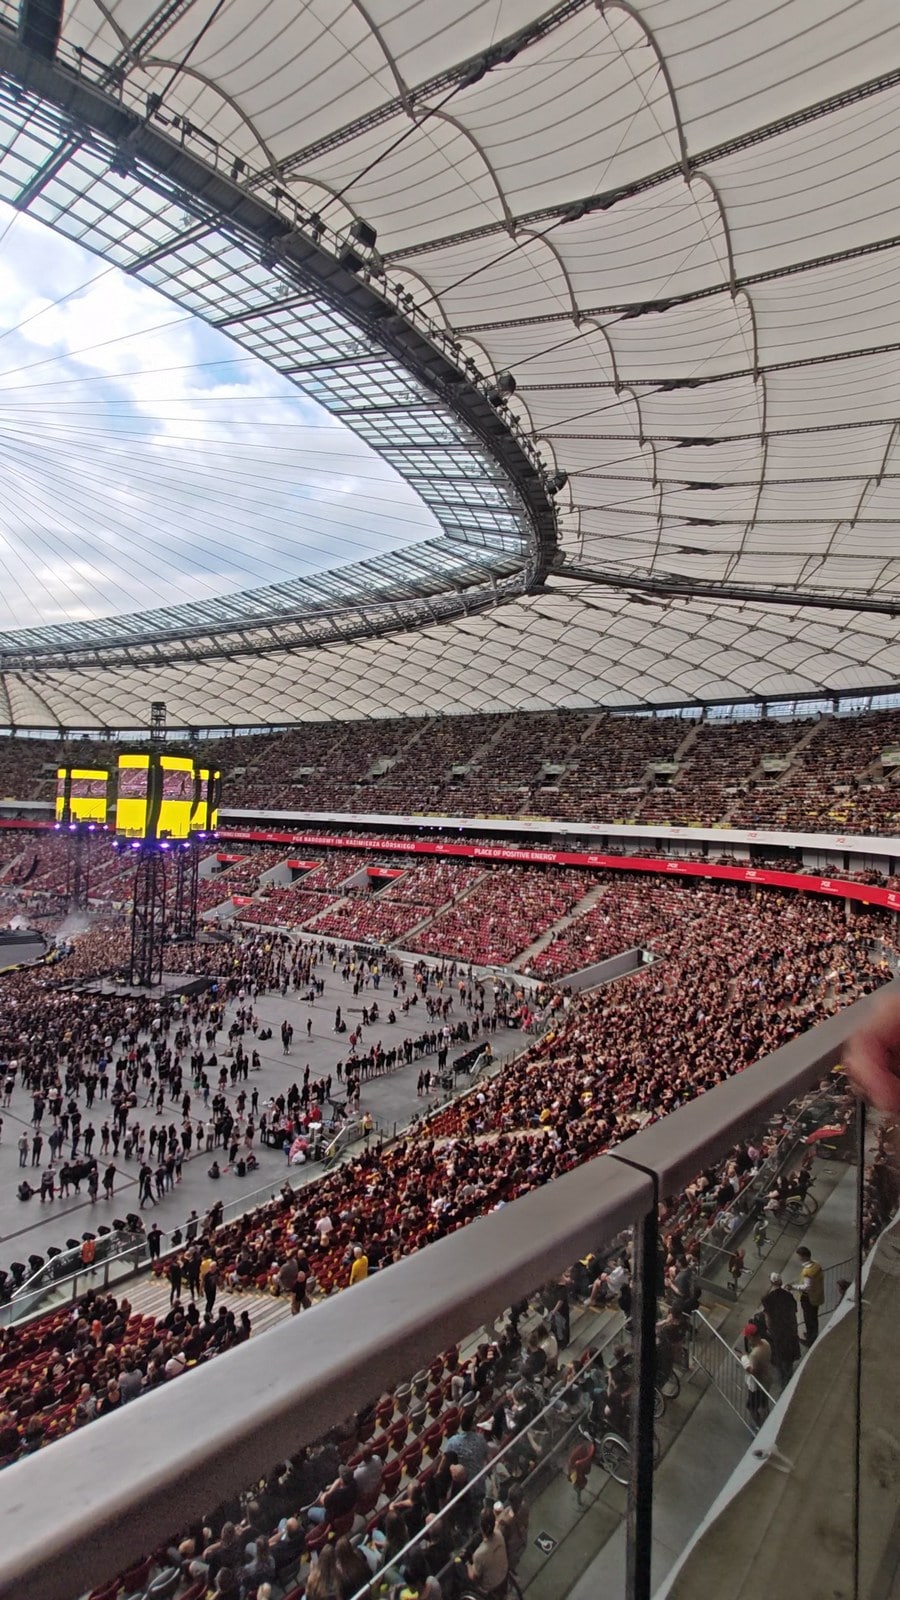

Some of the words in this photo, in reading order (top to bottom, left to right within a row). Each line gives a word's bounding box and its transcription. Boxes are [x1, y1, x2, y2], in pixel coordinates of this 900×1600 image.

[474, 848, 492, 856] PLACE
[502, 850, 530, 859] POSITIVE
[531, 853, 557, 861] ENERGY
